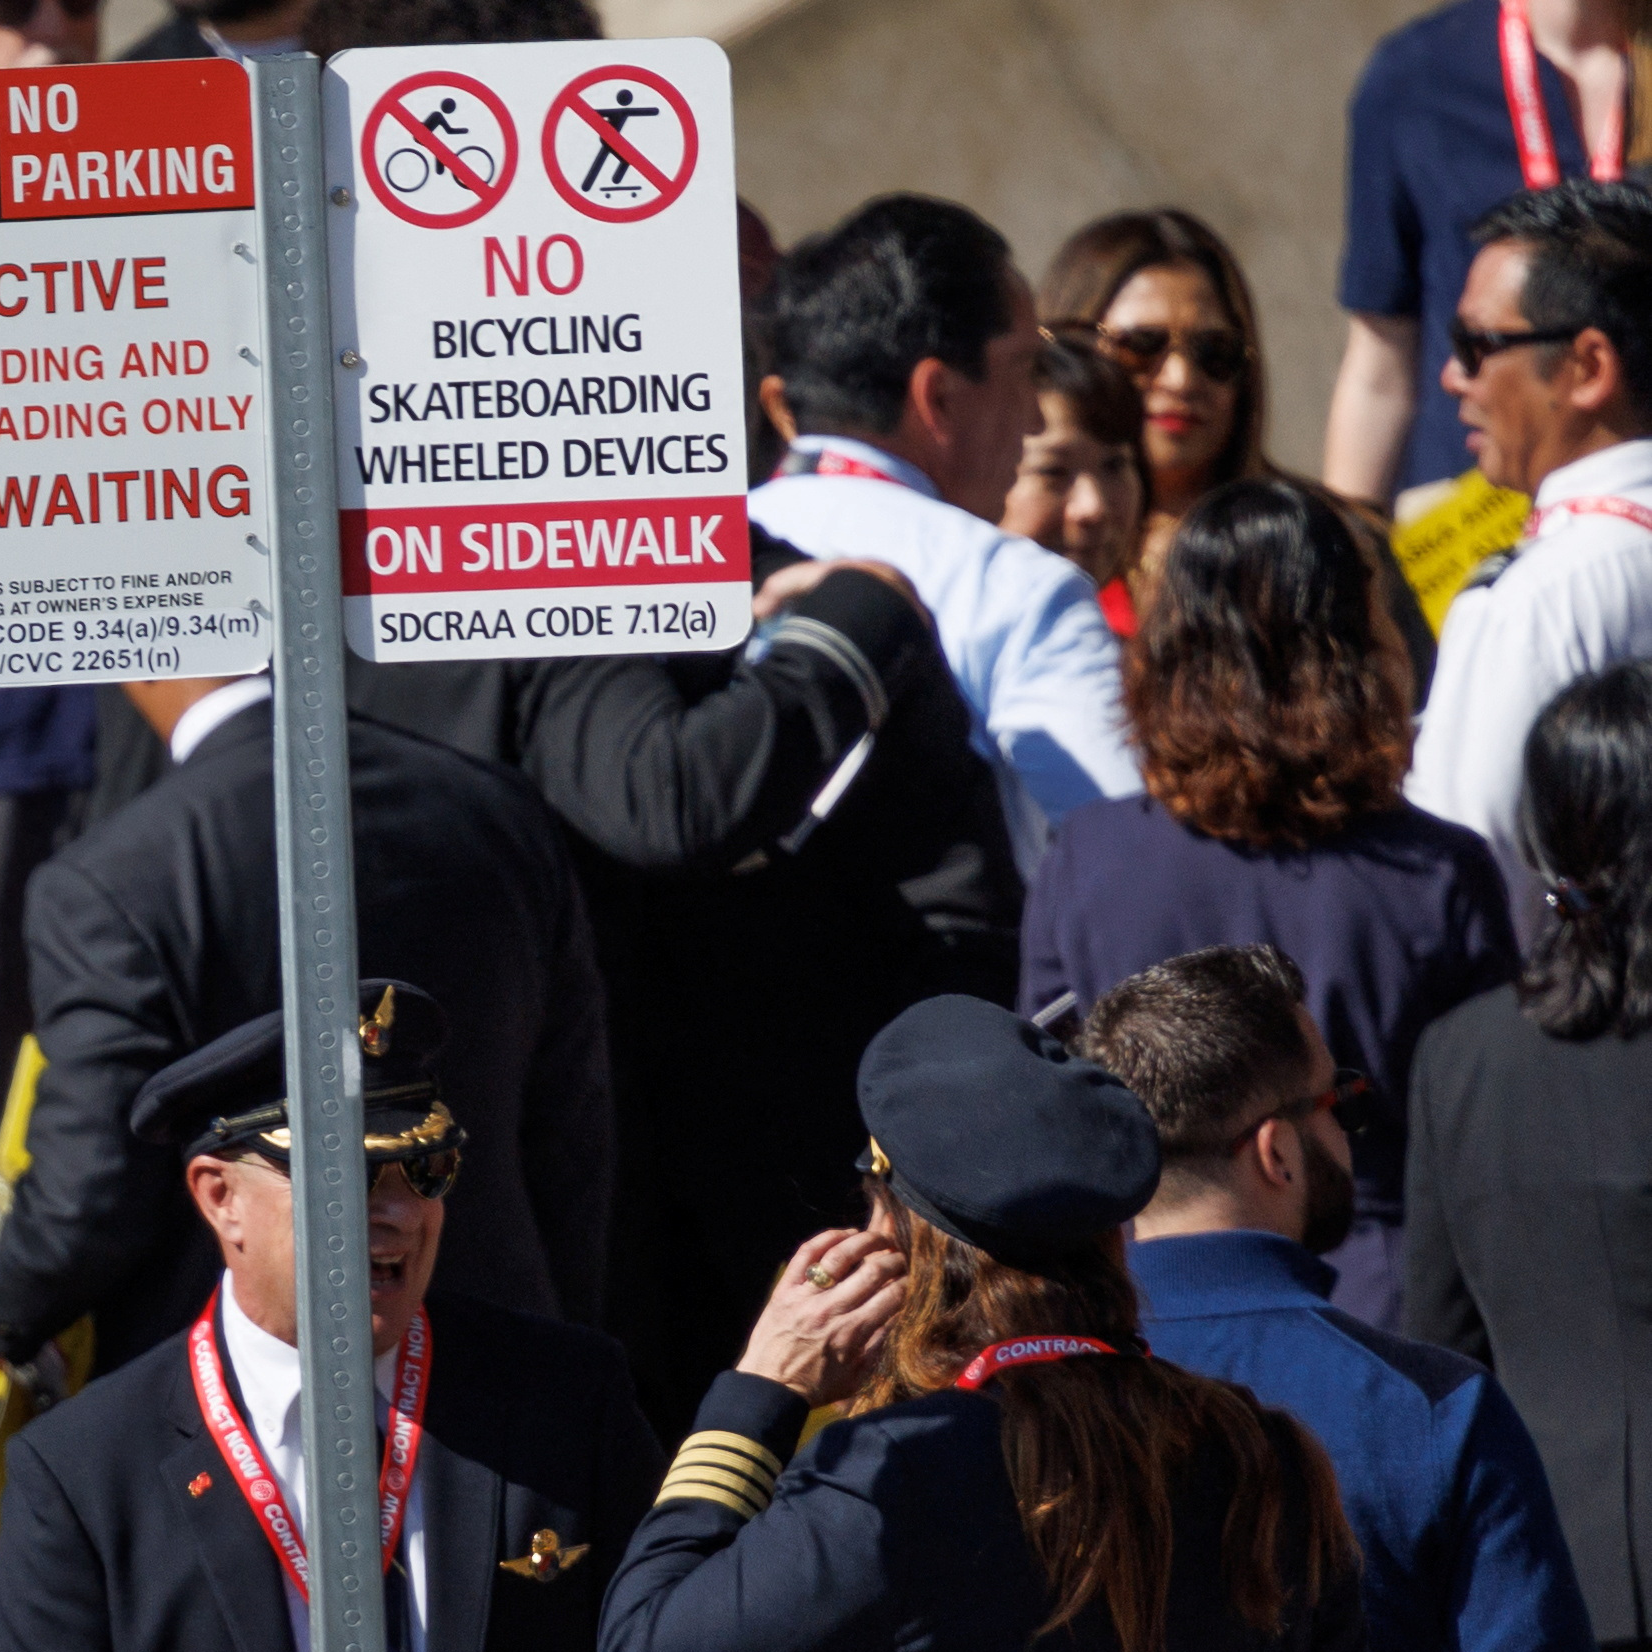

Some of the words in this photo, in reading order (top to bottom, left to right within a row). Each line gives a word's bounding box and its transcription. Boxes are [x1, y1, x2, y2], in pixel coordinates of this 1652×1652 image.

[9, 84, 78, 133] NO
[12, 144, 234, 202] PARKING
[484, 234, 584, 297] NO
[433, 314, 641, 358] BICYCLING
[120, 340, 209, 378] AND
[143, 395, 252, 434] ONLY
[369, 373, 710, 423] SKATEBOARDING
[355, 440, 549, 487] WHEELED
[564, 434, 728, 477] DEVICES
[367, 526, 442, 575] ON
[461, 515, 726, 572] SIDEWALK
[9, 578, 90, 595] SUBJECT
[93, 577, 115, 591] TO
[121, 574, 160, 589] FINE
[165, 571, 232, 587] AND/OR
[10, 601, 32, 615] AT
[36, 597, 118, 614] OWNER'S
[124, 593, 204, 609] EXPENSE
[74, 612, 260, 643] 9.34(a)/9.34(m)
[381, 609, 515, 643] SDCRAA
[526, 606, 613, 637] CODE
[625, 601, 716, 639] 7.12(a)
[72, 647, 180, 673] 22651(n)
[407, 1314, 425, 1359] NOW
[195, 1340, 235, 1431] CONTRACT
[224, 1431, 262, 1479] NOW
[392, 1361, 423, 1464] CONTRACT
